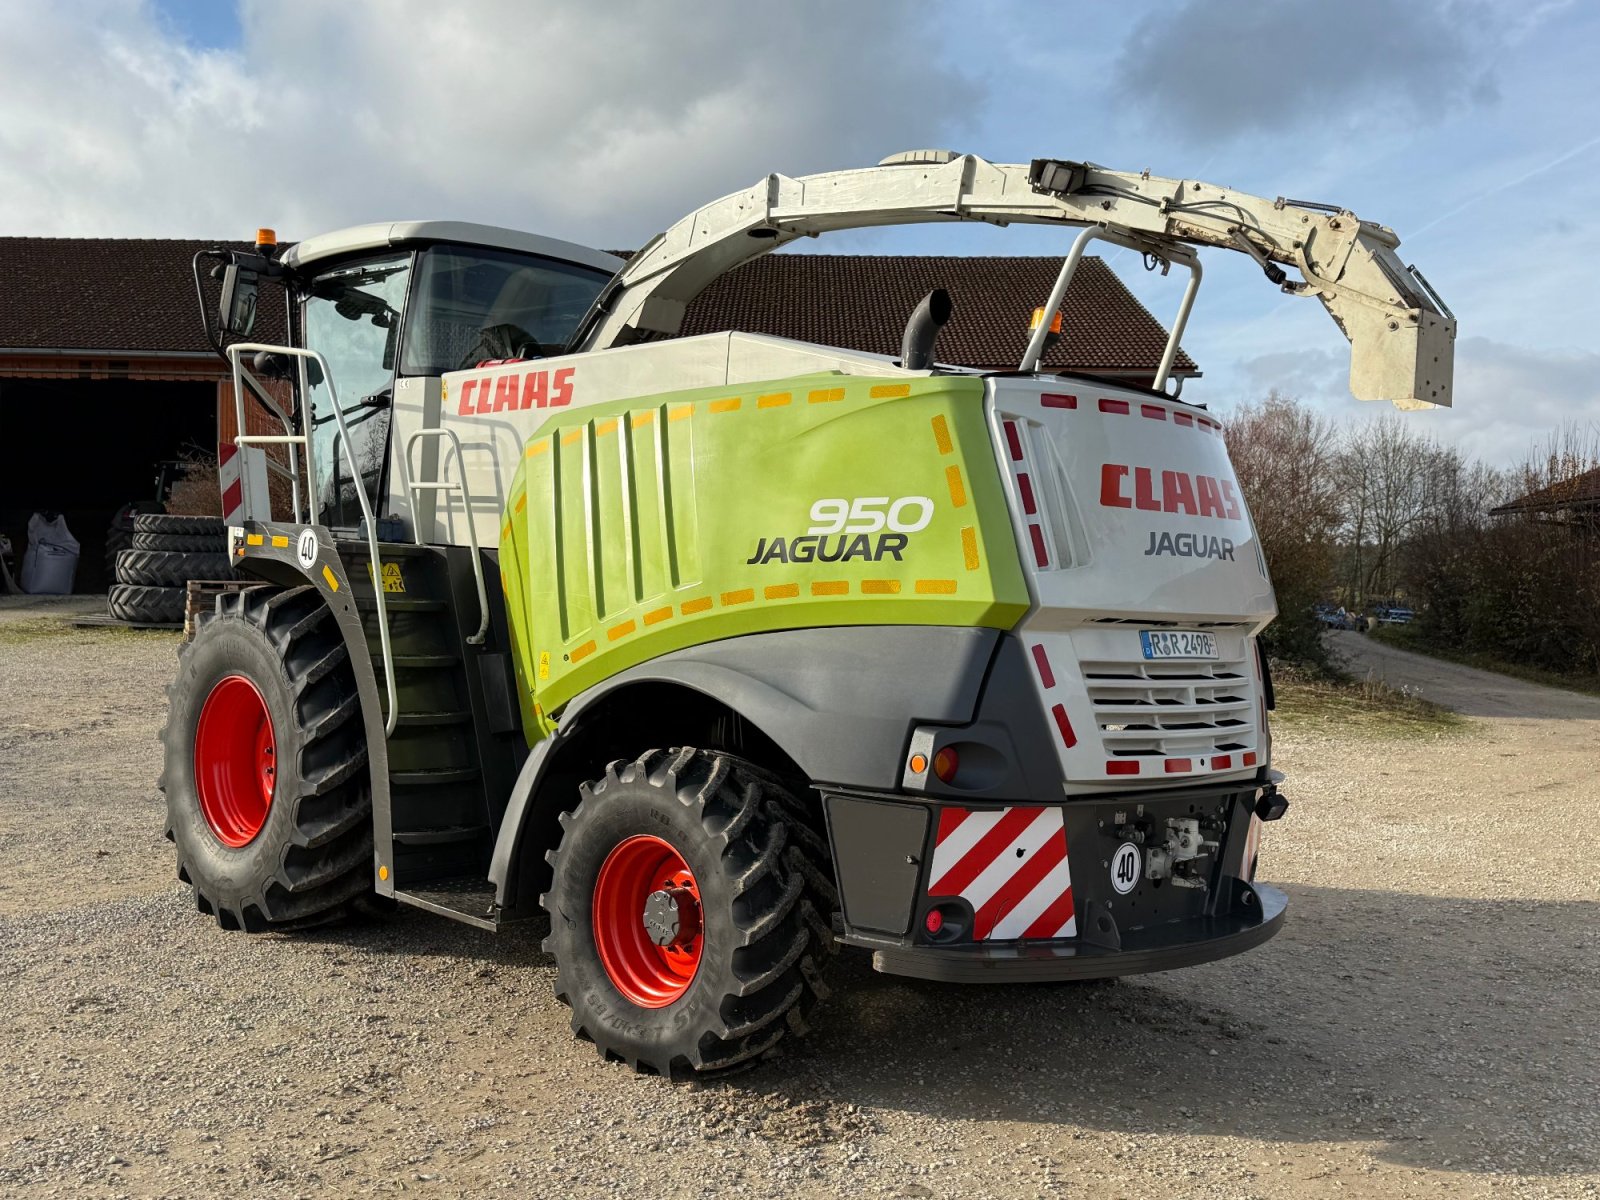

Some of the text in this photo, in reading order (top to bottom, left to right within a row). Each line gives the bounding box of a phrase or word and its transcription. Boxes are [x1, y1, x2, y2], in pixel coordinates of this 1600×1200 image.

[458, 367, 575, 416] CLAAS
[1100, 463, 1242, 521] CLAAS
[807, 496, 935, 535] 950
[300, 536, 314, 561] 40
[746, 533, 909, 565] JAGUAR
[1144, 531, 1236, 562] JAGUAR
[1117, 851, 1135, 884] 40
